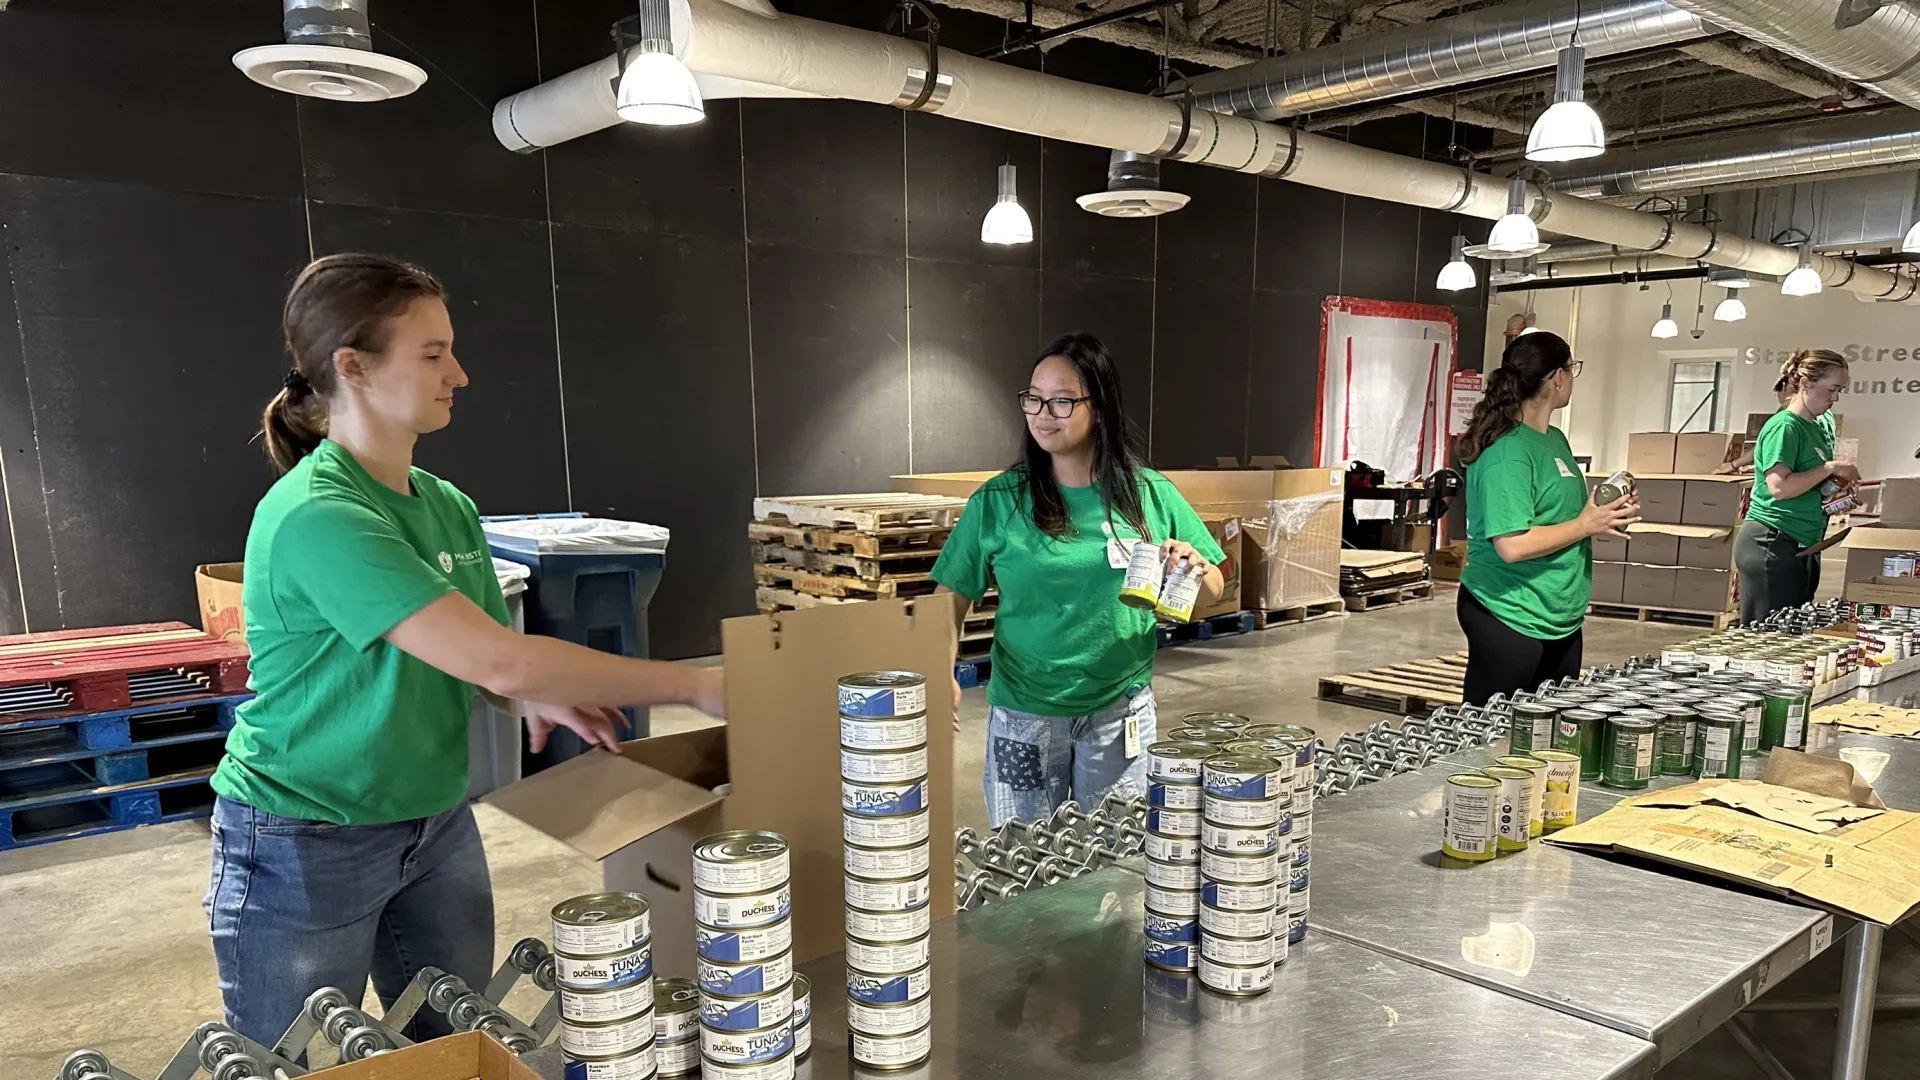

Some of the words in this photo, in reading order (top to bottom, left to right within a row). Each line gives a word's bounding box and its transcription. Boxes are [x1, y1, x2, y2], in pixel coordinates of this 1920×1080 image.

[1847, 376, 1920, 394] lunte
[1169, 766, 1197, 775] DUCHESS
[1207, 772, 1227, 786] TUNA
[854, 791, 883, 803] TUNA
[1236, 838, 1265, 847] DUCHESS
[741, 904, 775, 918] DUCHESS
[609, 955, 641, 973] TUNA
[573, 970, 607, 978] DUCHESS
[699, 966, 716, 980] UNA
[679, 1018, 700, 1031] DUCHE
[712, 1043, 745, 1054] DUCHESS
[746, 1033, 779, 1050] TUNA
